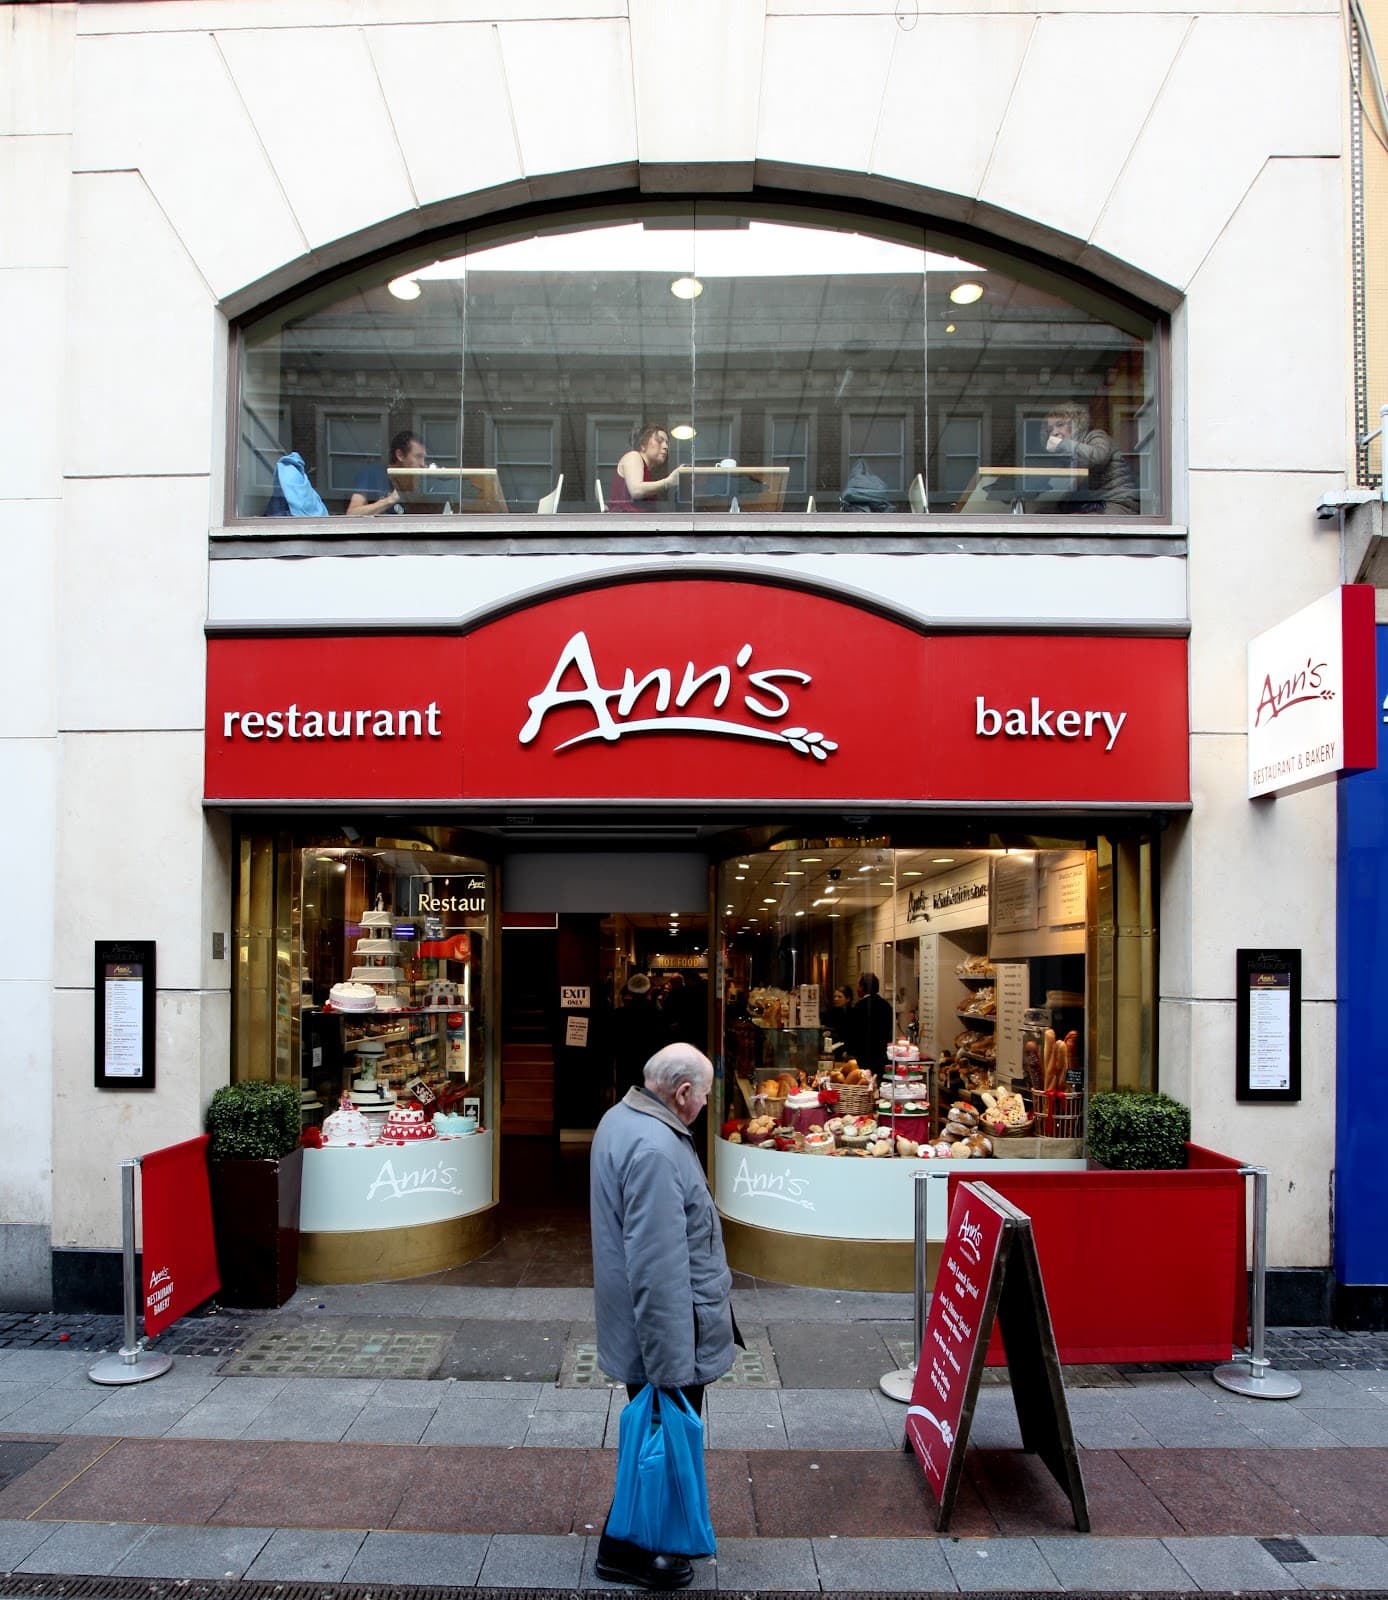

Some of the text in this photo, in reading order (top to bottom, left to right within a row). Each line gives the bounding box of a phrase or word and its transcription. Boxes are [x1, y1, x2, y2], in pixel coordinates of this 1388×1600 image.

[518, 630, 813, 744] Ann's
[1254, 657, 1328, 728] Ann's
[223, 702, 442, 739] restaurant
[976, 696, 1128, 751] bakery
[1253, 741, 1336, 786] RESTAURANT & BAKERY
[563, 988, 586, 999] EXIT
[366, 1160, 458, 1200] Ann's
[733, 1157, 810, 1196] Ann's
[958, 1210, 982, 1246] Ann's
